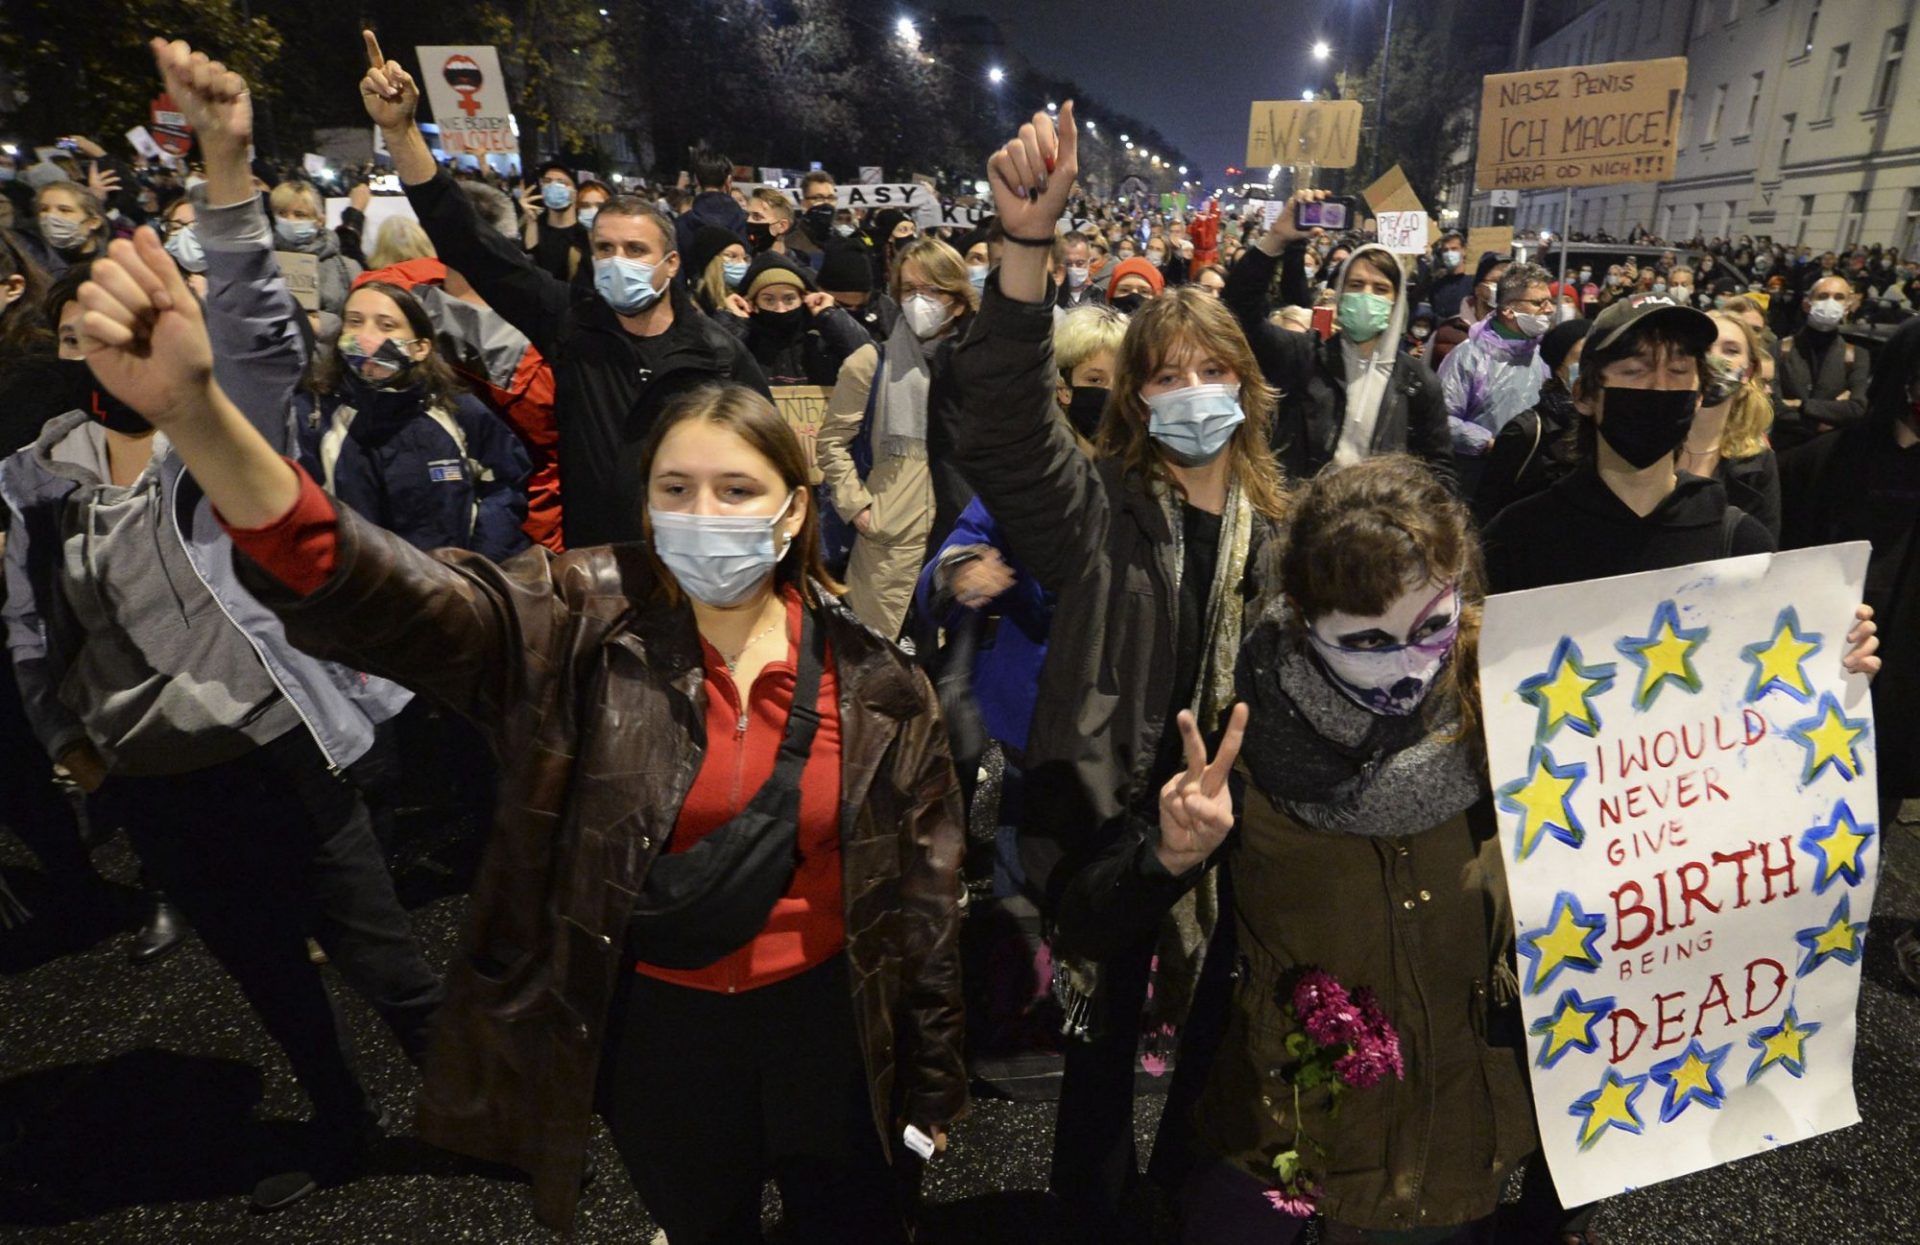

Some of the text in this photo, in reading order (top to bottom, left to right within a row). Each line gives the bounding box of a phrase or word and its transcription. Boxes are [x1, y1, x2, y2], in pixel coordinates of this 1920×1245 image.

[1499, 71, 1637, 108] NASZ PENIS
[1499, 117, 1549, 162] ICH
[1494, 163, 1546, 186] WARA
[1556, 164, 1582, 179] OD
[1597, 708, 1767, 785] I WOULD
[1600, 767, 1731, 829] NEVER
[1607, 818, 1688, 867] GIVE
[1608, 834, 1800, 952] BIRTH
[1619, 930, 1713, 982] BEING
[1607, 957, 1789, 1065] DEAD
